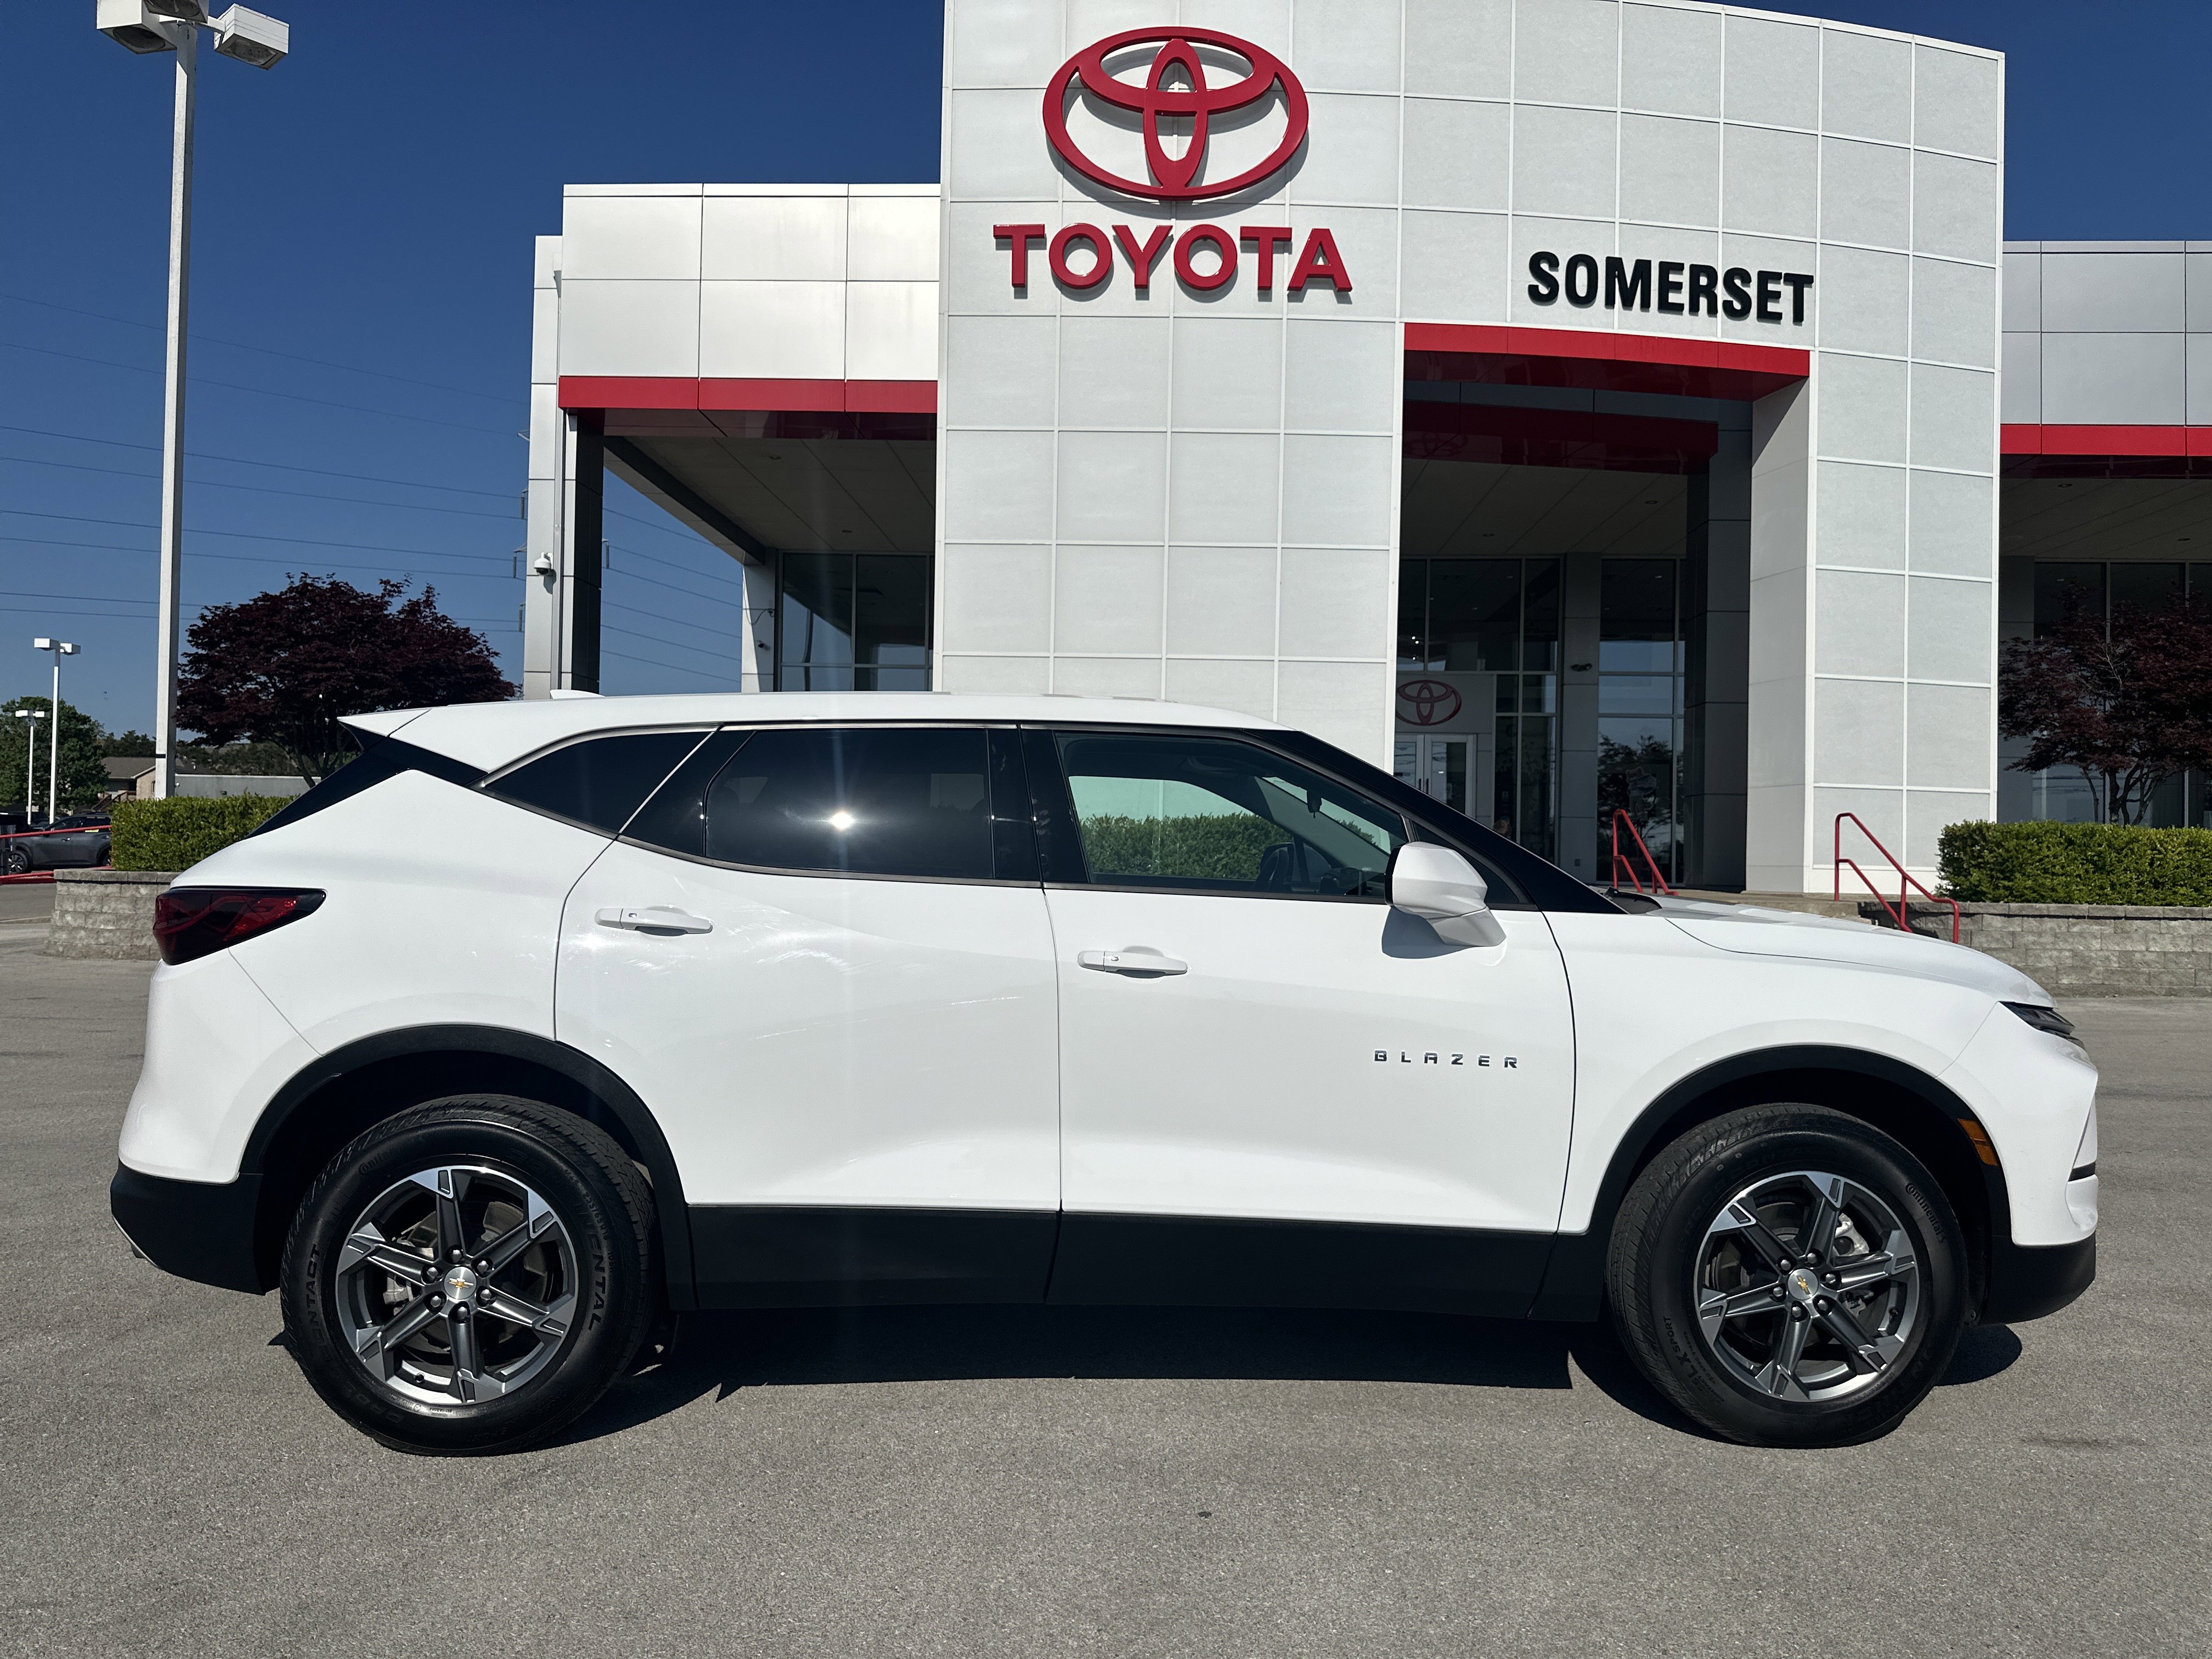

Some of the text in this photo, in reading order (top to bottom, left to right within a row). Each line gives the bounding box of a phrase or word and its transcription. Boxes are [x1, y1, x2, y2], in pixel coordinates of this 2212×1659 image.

[993, 223, 1352, 292] TOYOTA
[1528, 251, 1814, 323] SOMERSET
[1374, 1049, 1517, 1069] BLAZER
[1905, 1182, 1944, 1235] Continental
[306, 1244, 334, 1361] CONTACT
[1663, 1315, 1681, 1353] SPORT
